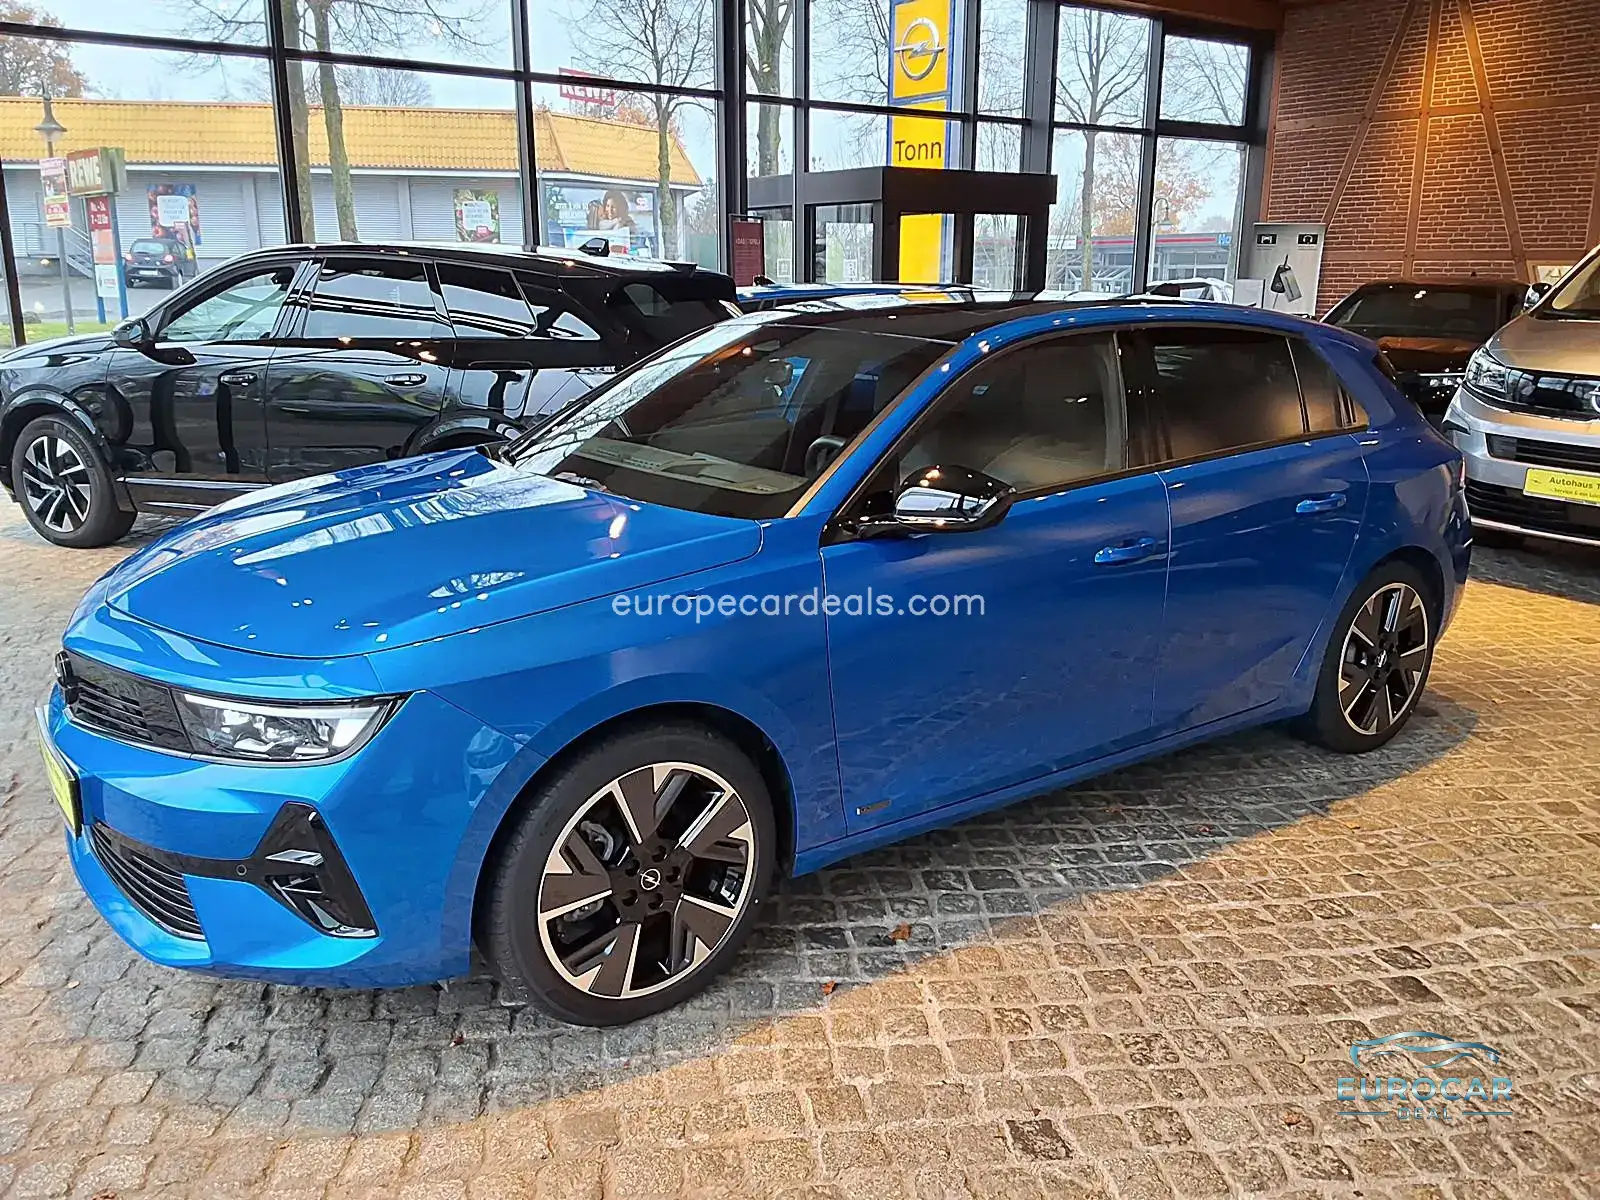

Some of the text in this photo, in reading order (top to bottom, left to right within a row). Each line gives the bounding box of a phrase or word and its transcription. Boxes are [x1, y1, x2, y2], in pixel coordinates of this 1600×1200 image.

[894, 139, 942, 162] Tonn
[68, 155, 102, 189] REWE
[1549, 476, 1593, 489] Autohaus
